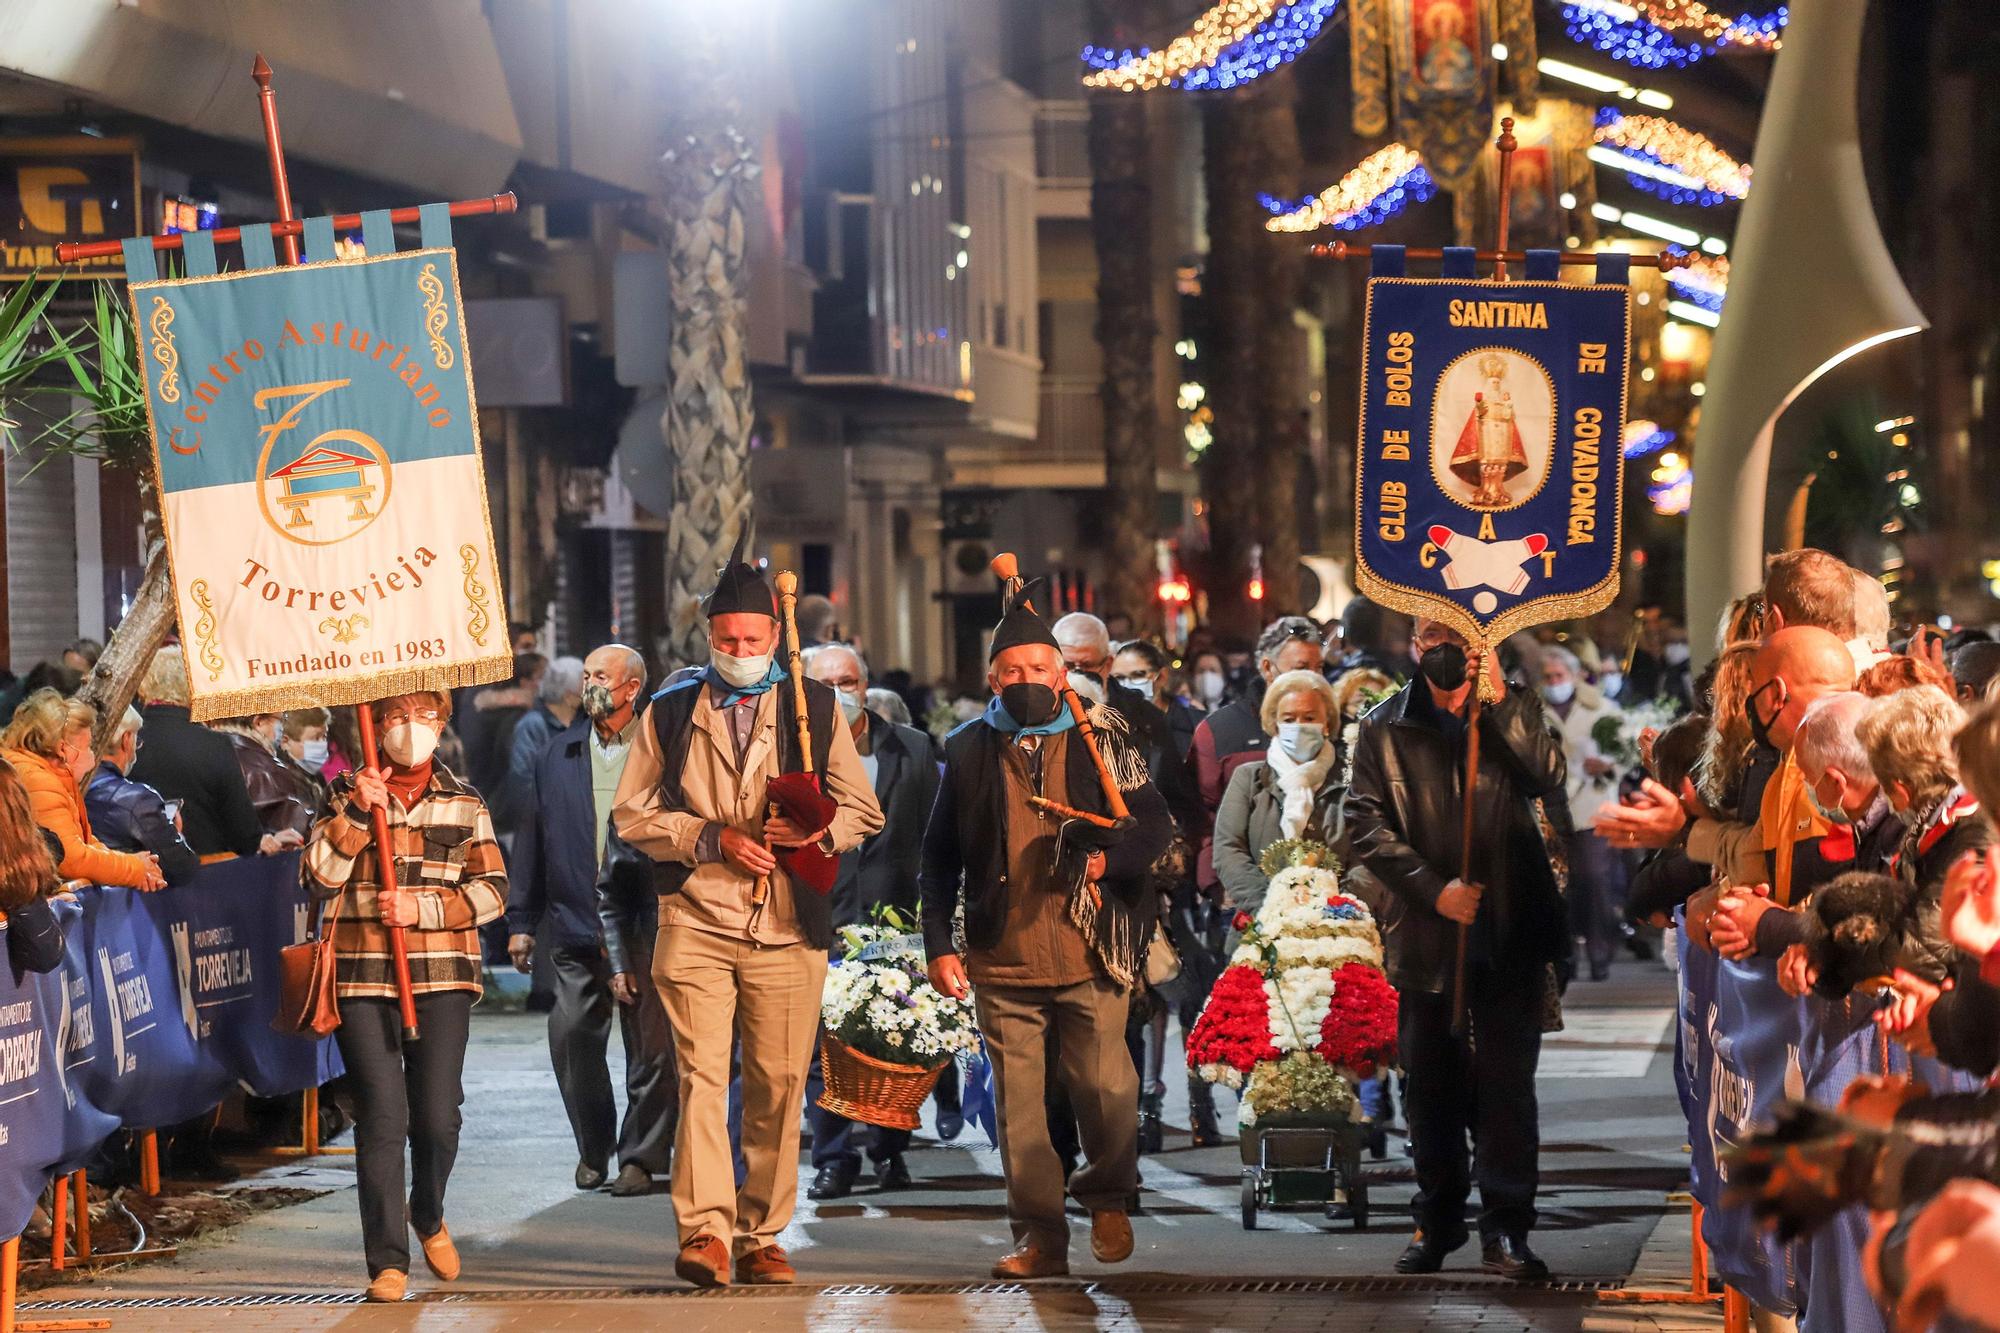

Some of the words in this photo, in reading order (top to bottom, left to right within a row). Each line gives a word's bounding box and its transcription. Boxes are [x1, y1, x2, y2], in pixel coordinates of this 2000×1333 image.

[1449, 299, 1549, 330] SANTINA
[1385, 331, 1415, 407] BOLOS
[1578, 342, 1607, 374] DE
[169, 338, 264, 456] Centro
[279, 319, 452, 429] Asturiano
[1382, 429, 1411, 461] DE
[1567, 407, 1602, 546] COVADONGA
[1379, 481, 1408, 542] CLUB
[1478, 513, 1496, 540] A
[239, 546, 437, 611] Torrevieja
[1540, 551, 1557, 578] T
[247, 650, 351, 678] Fundado
[360, 649, 385, 665] en
[394, 638, 446, 663] 1983
[195, 948, 252, 993] TORREVIEJA
